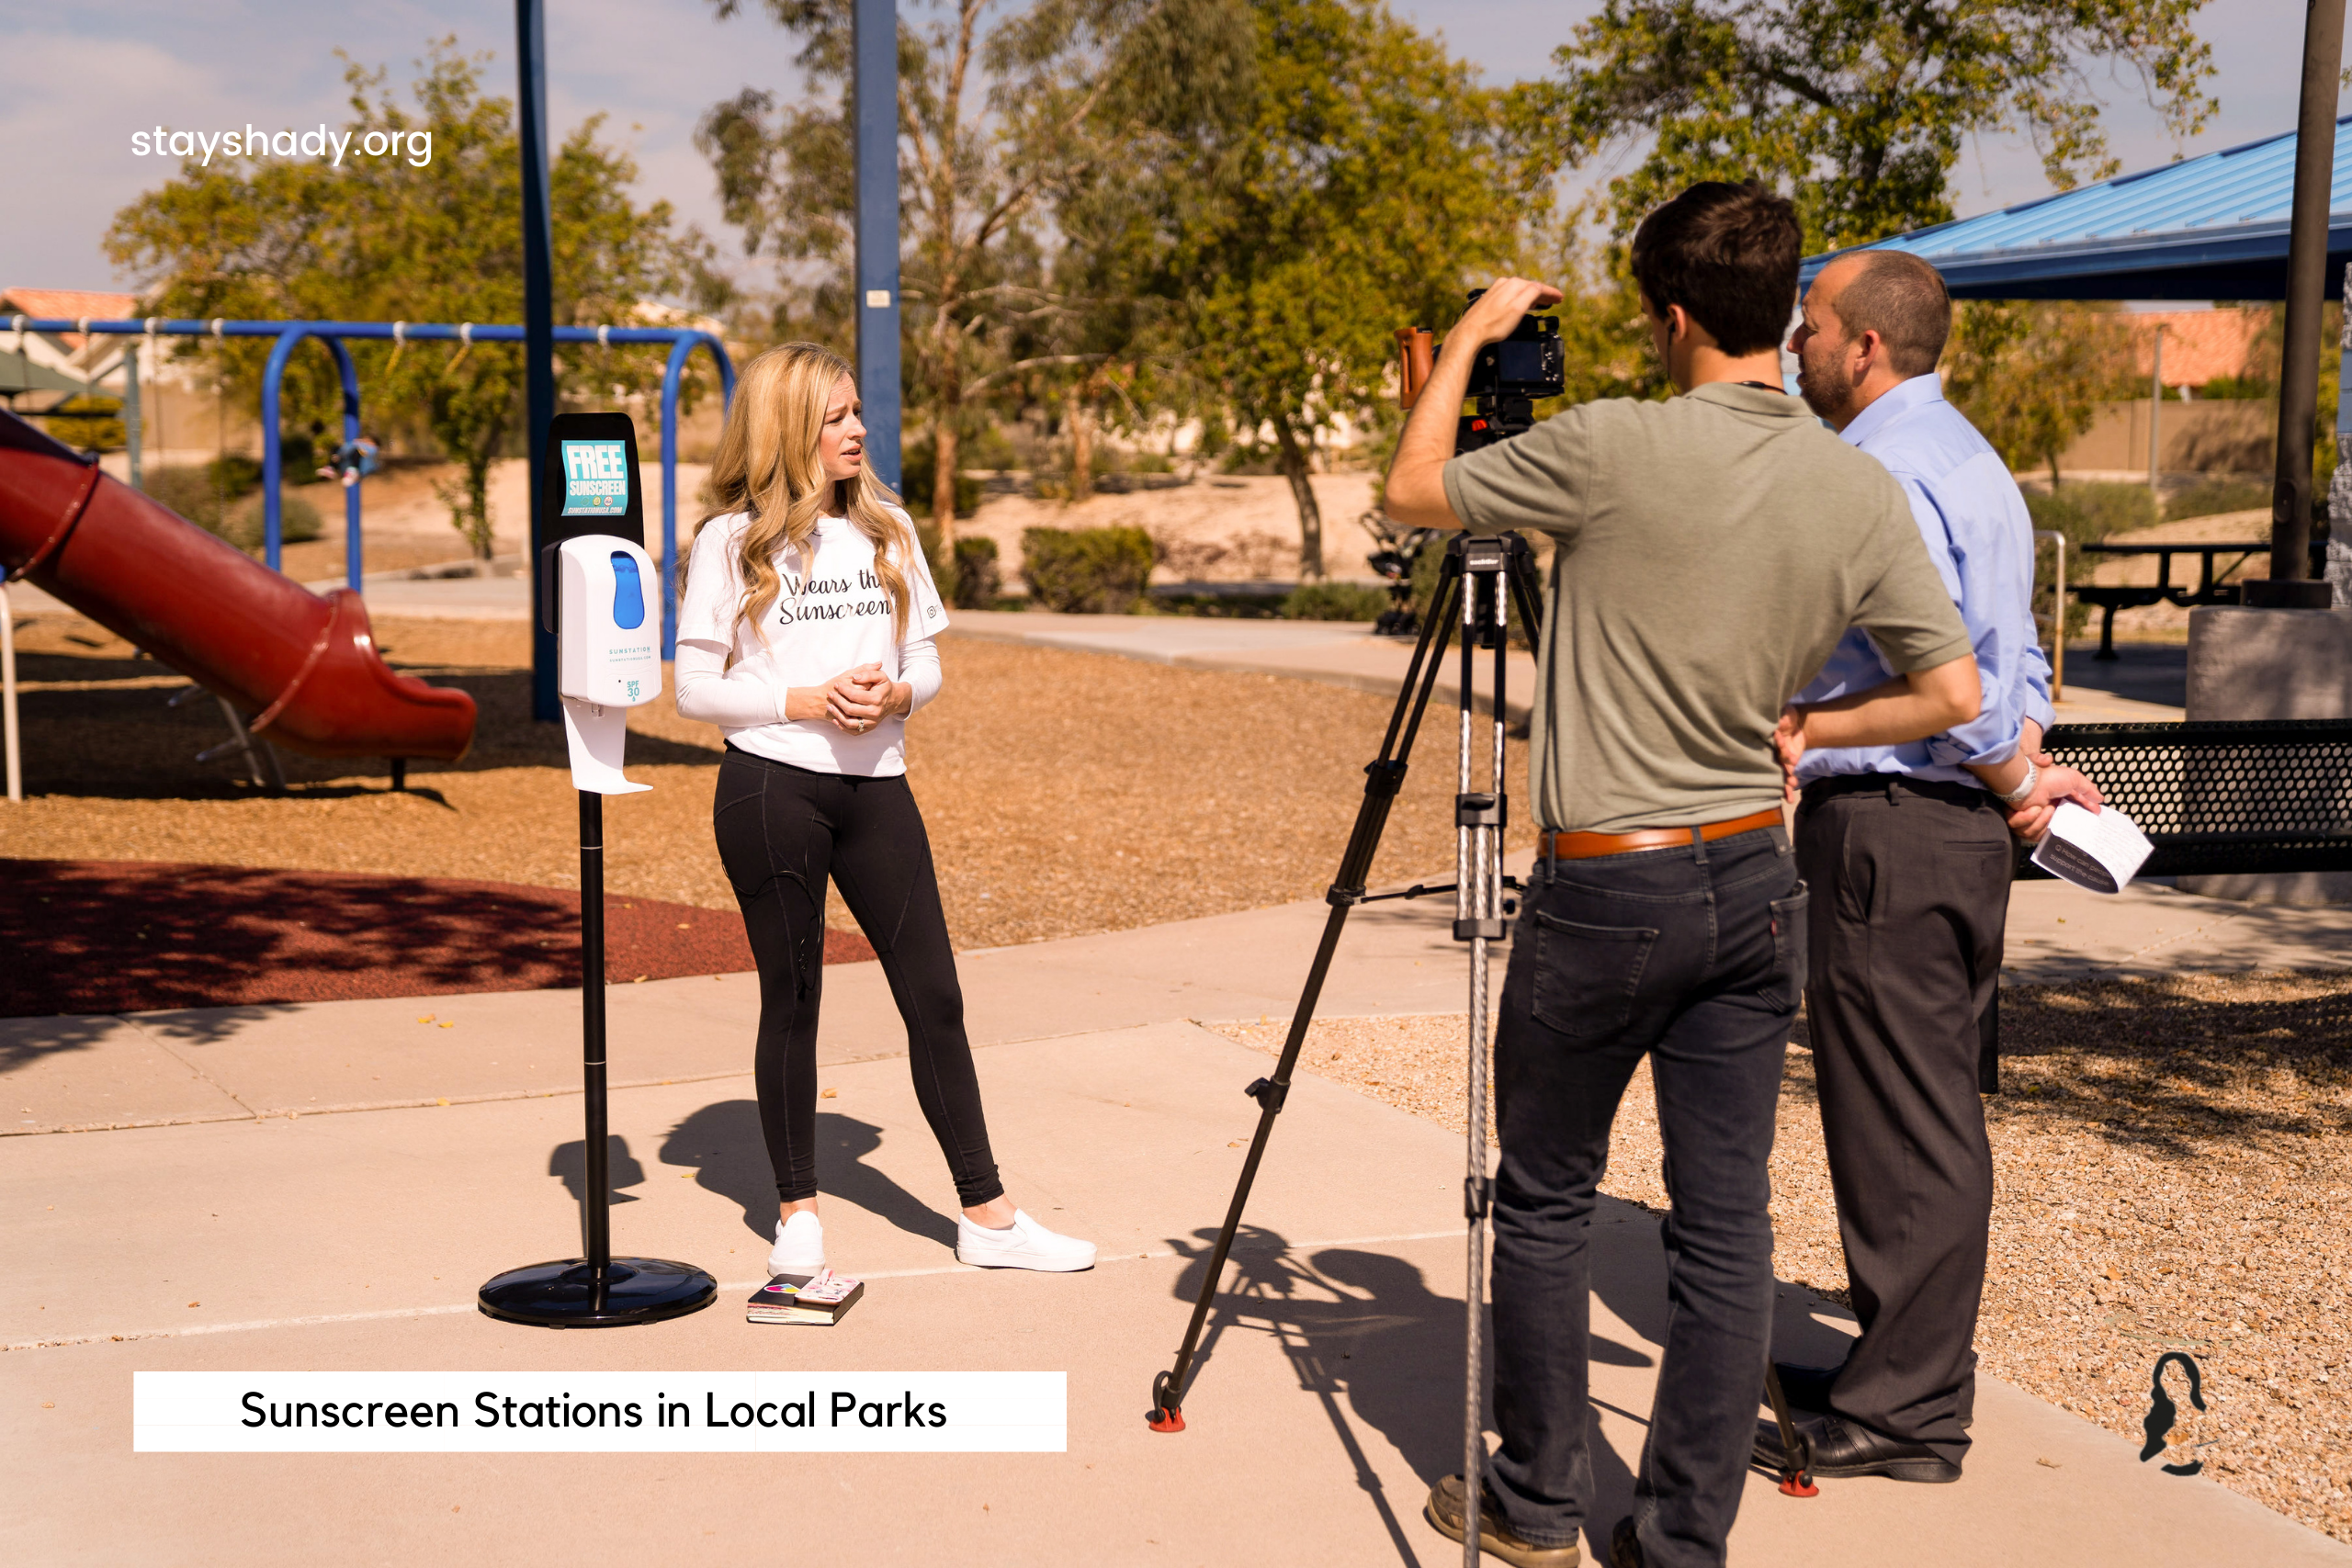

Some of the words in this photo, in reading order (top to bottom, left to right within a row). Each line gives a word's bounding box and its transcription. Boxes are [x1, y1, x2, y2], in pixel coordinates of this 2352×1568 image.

[567, 445, 624, 479] FREE
[570, 480, 626, 496] SUNSCREEN
[567, 506, 623, 514] SUNSTATIONUSA.COM
[782, 573, 852, 596] Wears
[857, 569, 881, 590] th
[779, 597, 891, 625] Sunscreen
[608, 646, 650, 654] SUNSTATION
[627, 680, 639, 688] SPF
[627, 687, 640, 696] 30
[2049, 853, 2075, 872] support
[2075, 868, 2086, 877] the
[2062, 848, 2076, 860] How
[2076, 858, 2089, 867] can
